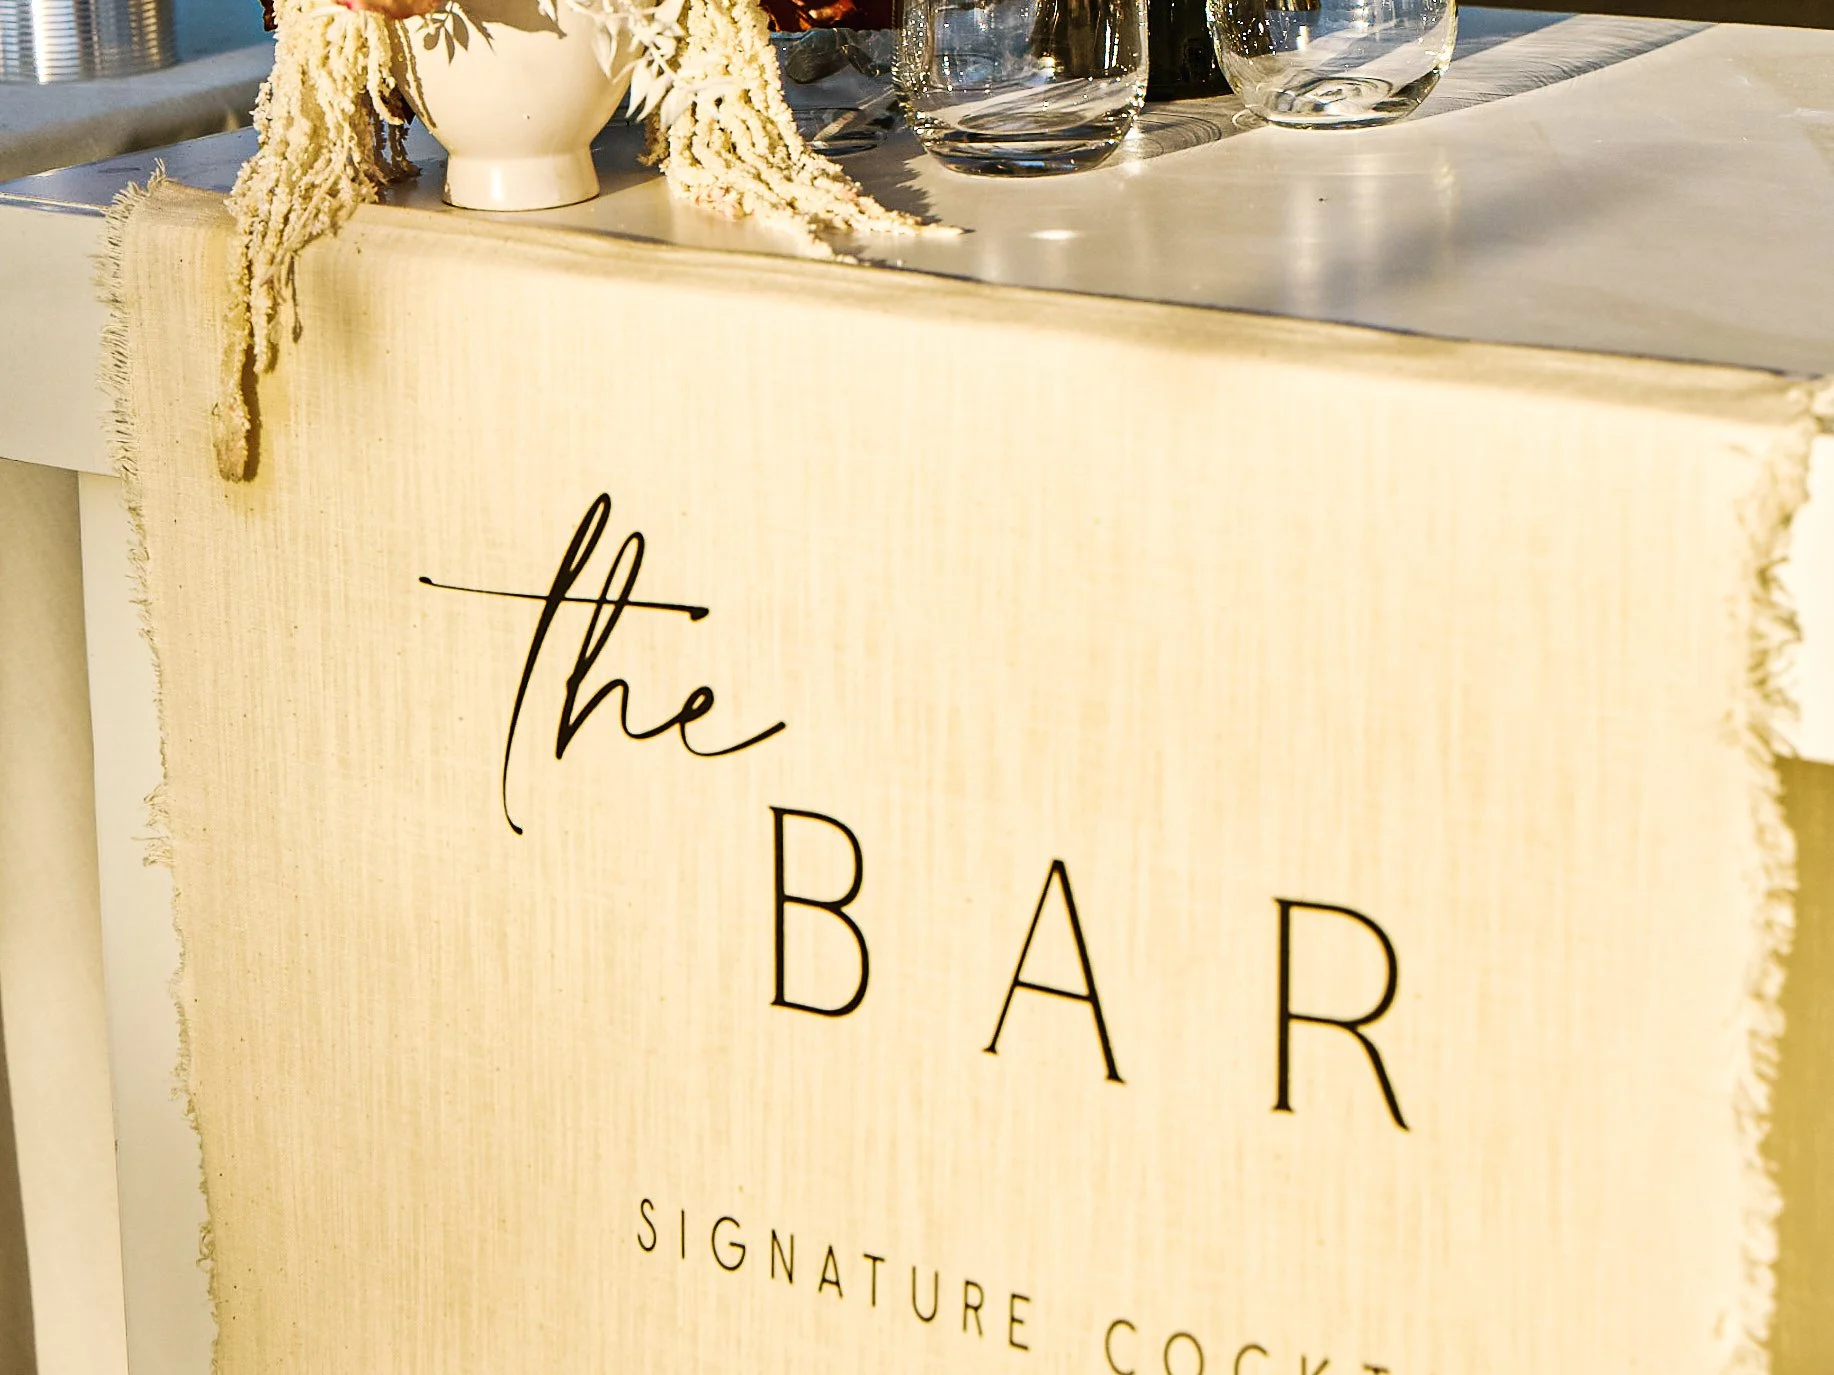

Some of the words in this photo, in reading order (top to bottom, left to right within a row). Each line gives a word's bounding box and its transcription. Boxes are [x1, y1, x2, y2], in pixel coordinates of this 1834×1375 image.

[419, 493, 786, 835] the
[769, 806, 1409, 1131] BAR
[637, 1198, 1031, 1351] SIGNATURE
[1105, 1319, 1390, 1375] COC
